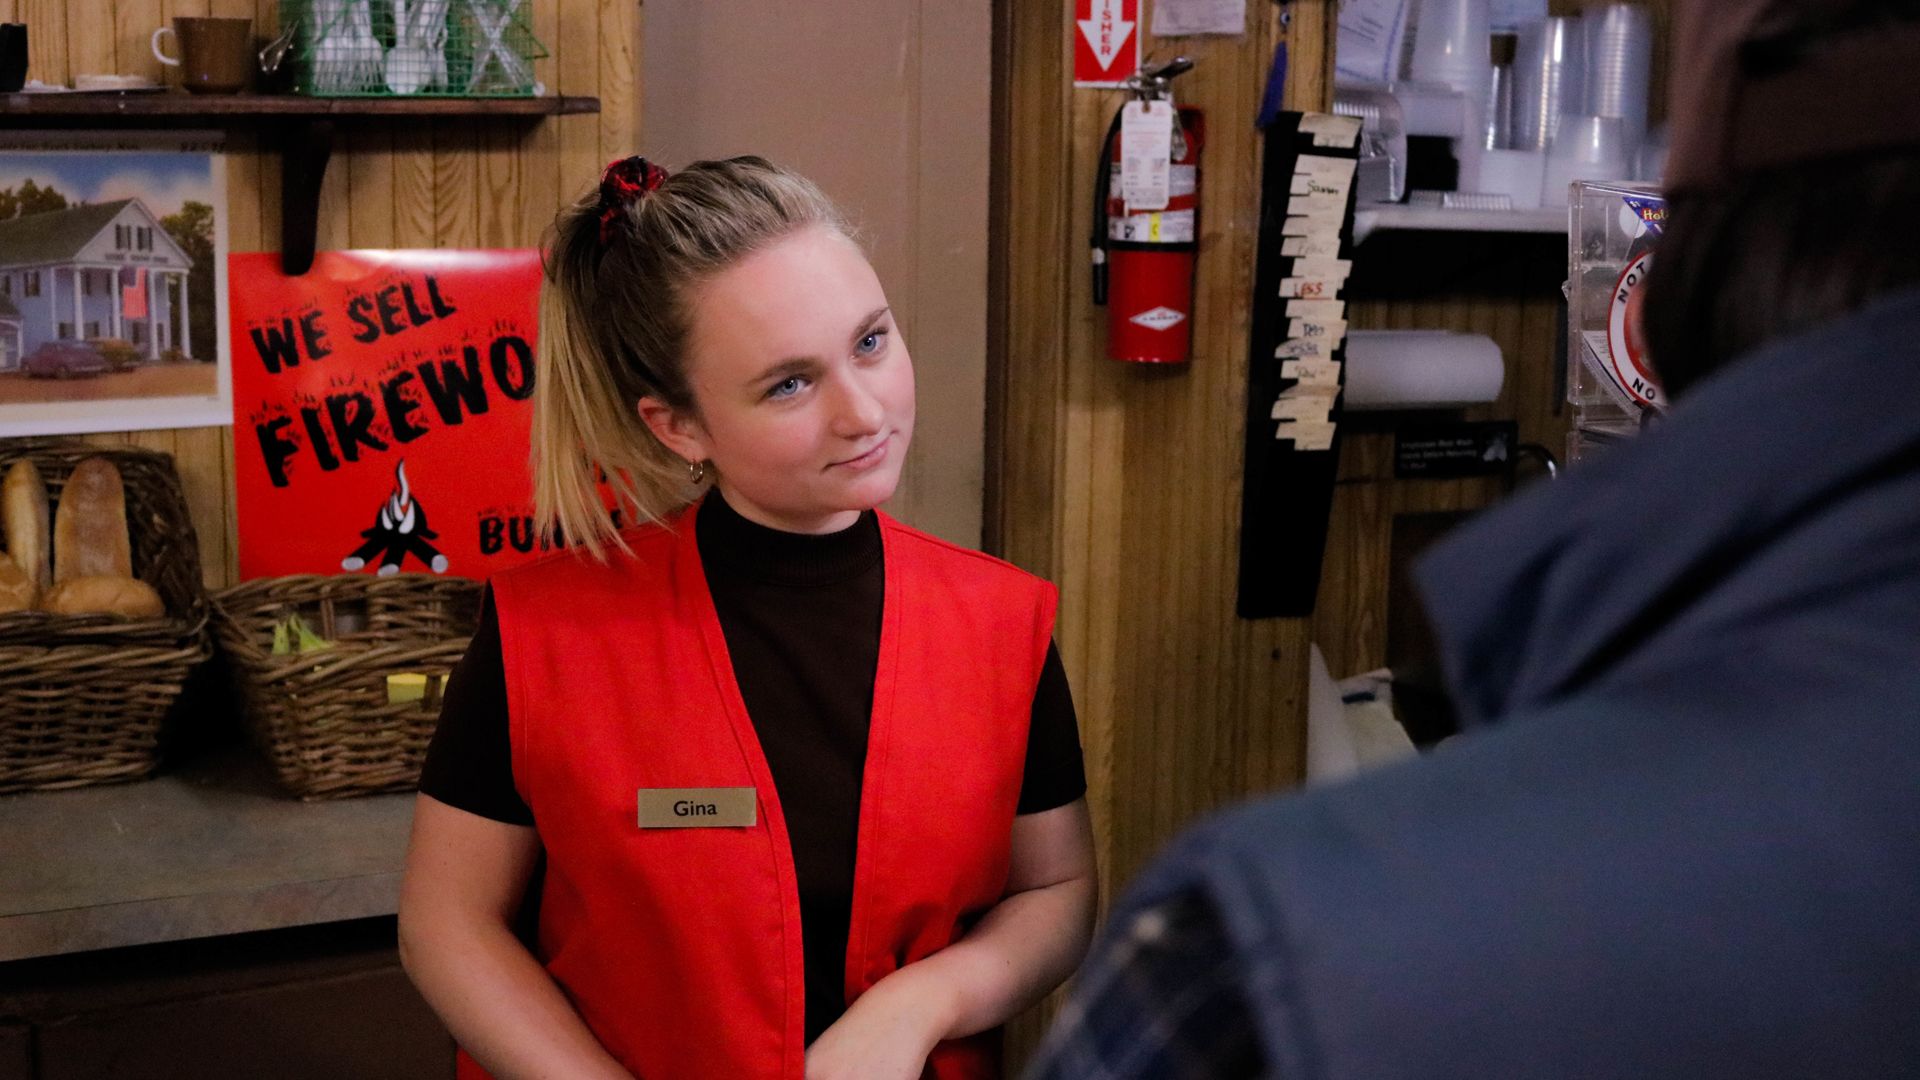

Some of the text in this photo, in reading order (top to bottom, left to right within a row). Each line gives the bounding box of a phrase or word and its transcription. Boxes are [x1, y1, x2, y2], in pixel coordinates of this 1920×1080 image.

[1617, 261, 1646, 304] NOT
[250, 275, 457, 374] WE SELL
[255, 335, 536, 488] FIREWO
[673, 800, 718, 817] Gina
